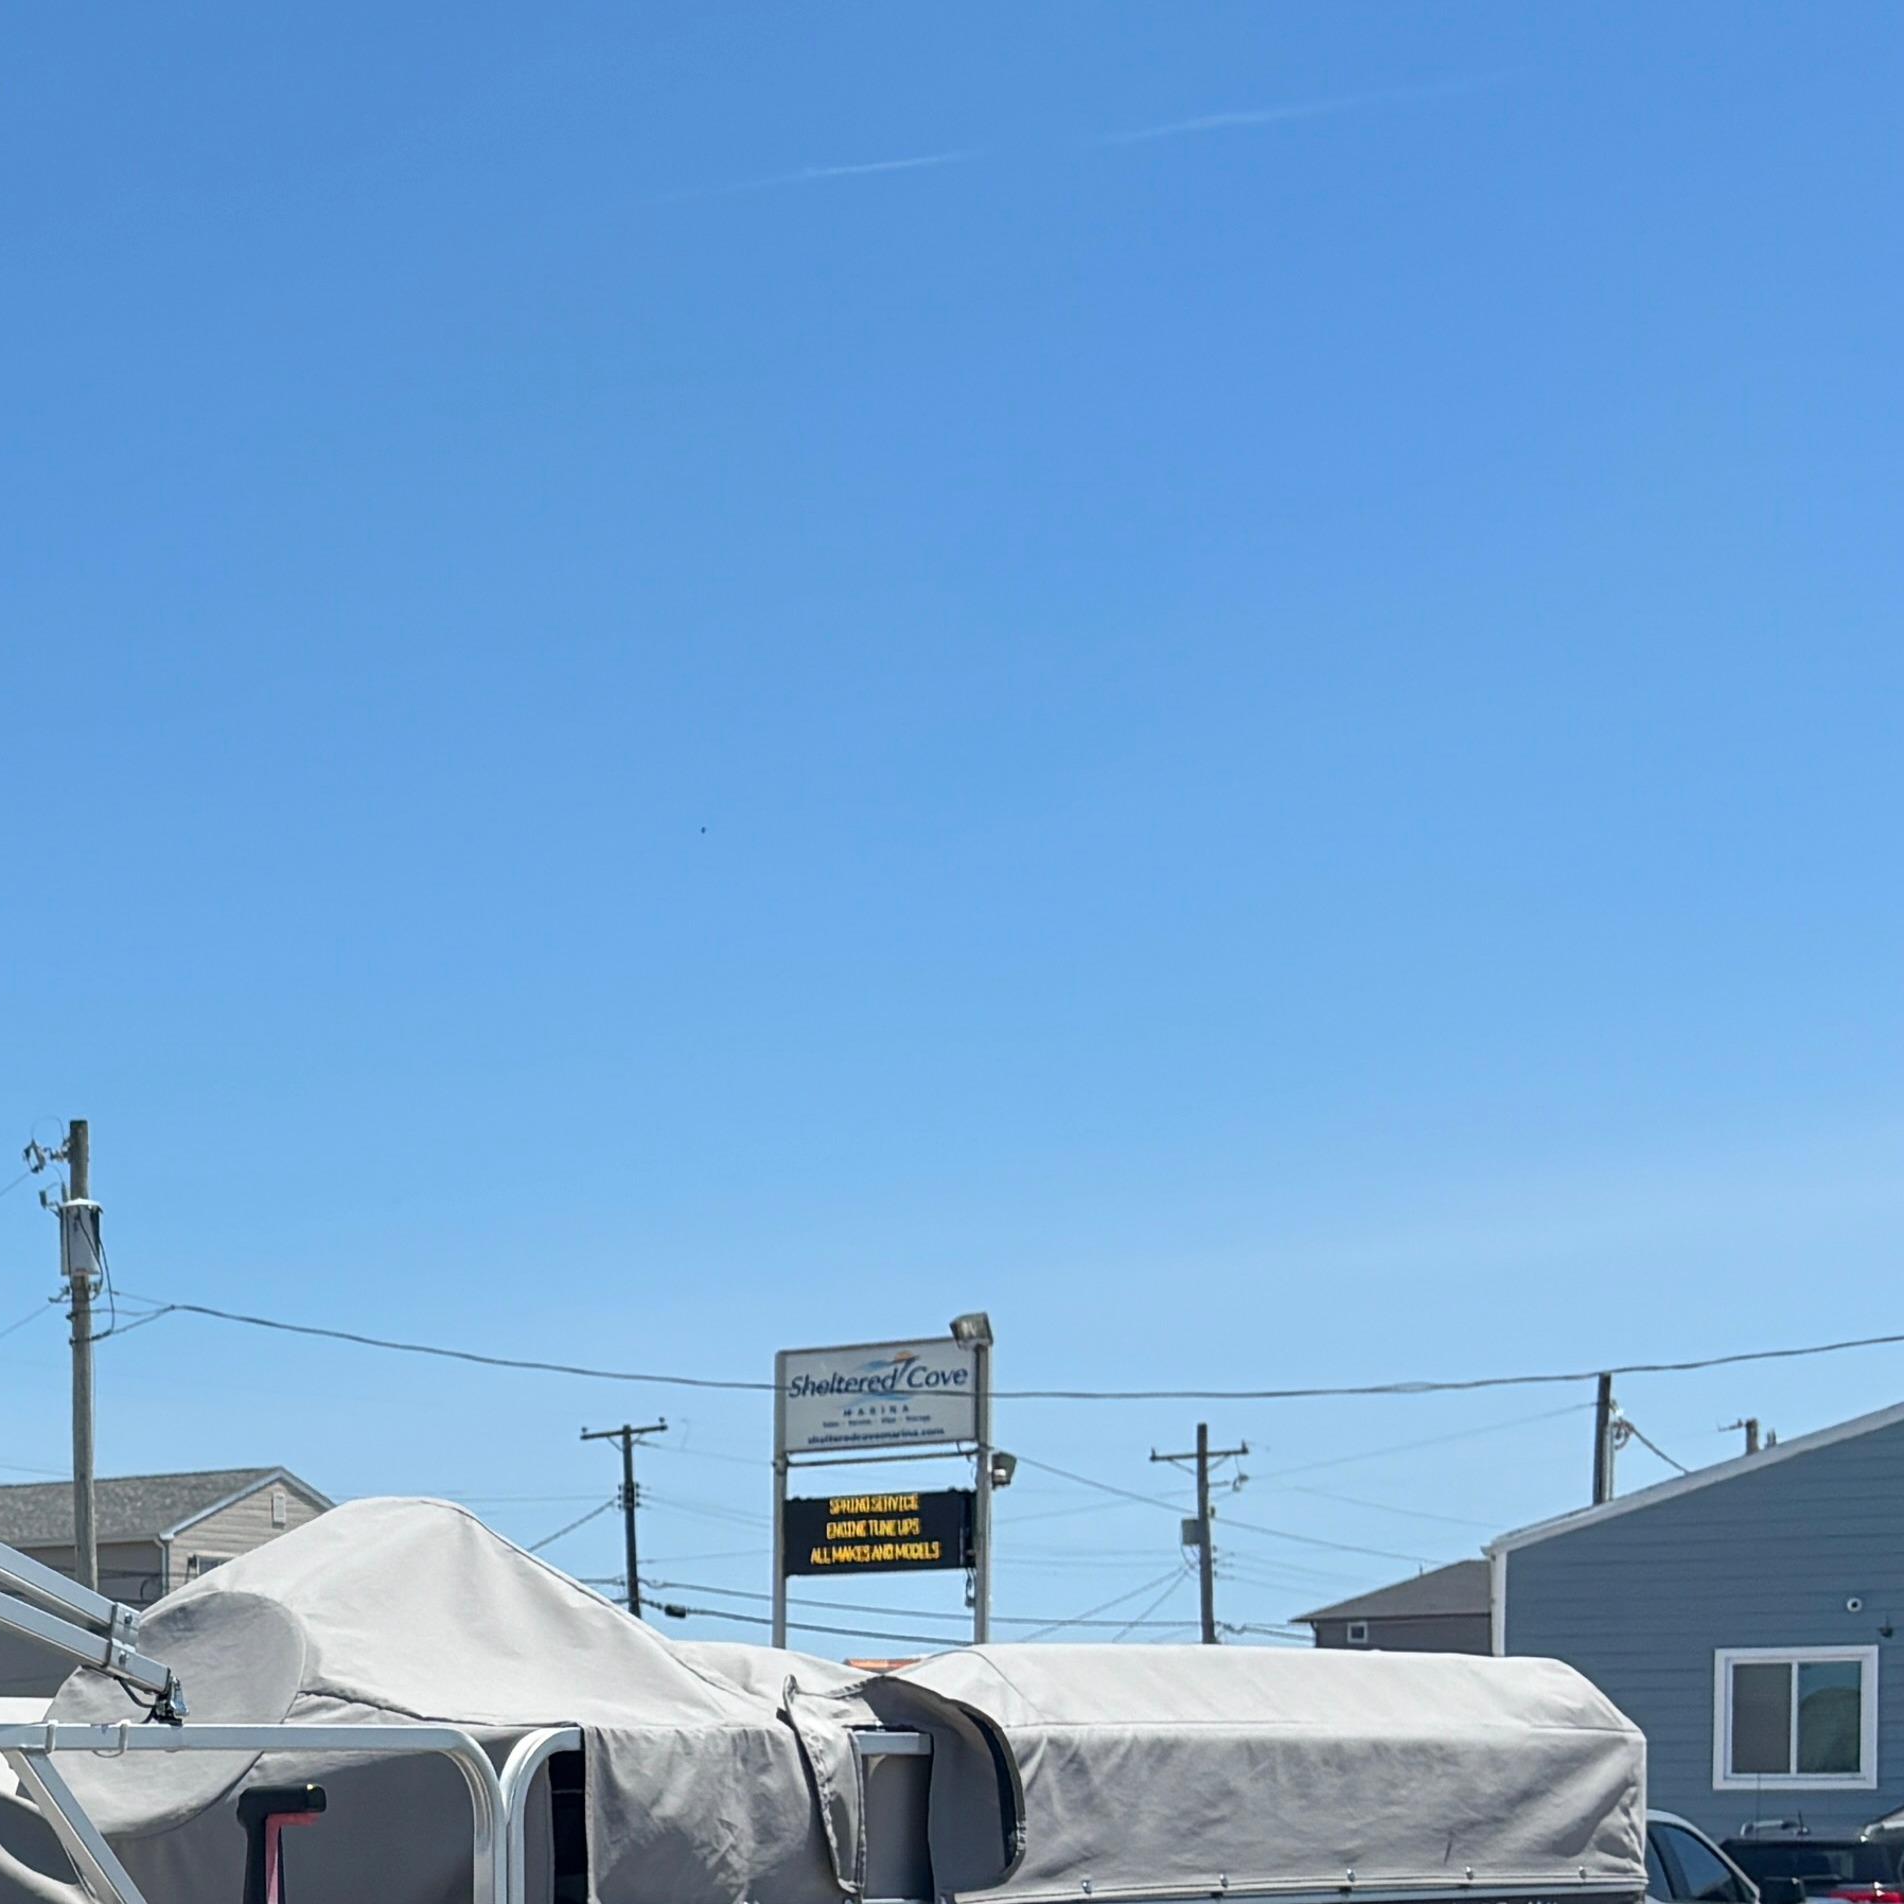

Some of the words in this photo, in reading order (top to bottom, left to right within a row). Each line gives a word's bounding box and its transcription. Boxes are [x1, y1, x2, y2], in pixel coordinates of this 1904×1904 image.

[789, 1365, 897, 1398] Sheltered
[906, 1365, 968, 1389] Cove
[843, 1404, 910, 1417] MARINA
[868, 1519, 896, 1537] TUNE
[897, 1518, 921, 1536] UPS
[810, 1546, 831, 1565] ALL
[832, 1544, 871, 1563] MAKES
[871, 1543, 896, 1561] AND
[896, 1541, 941, 1560] MODELS
